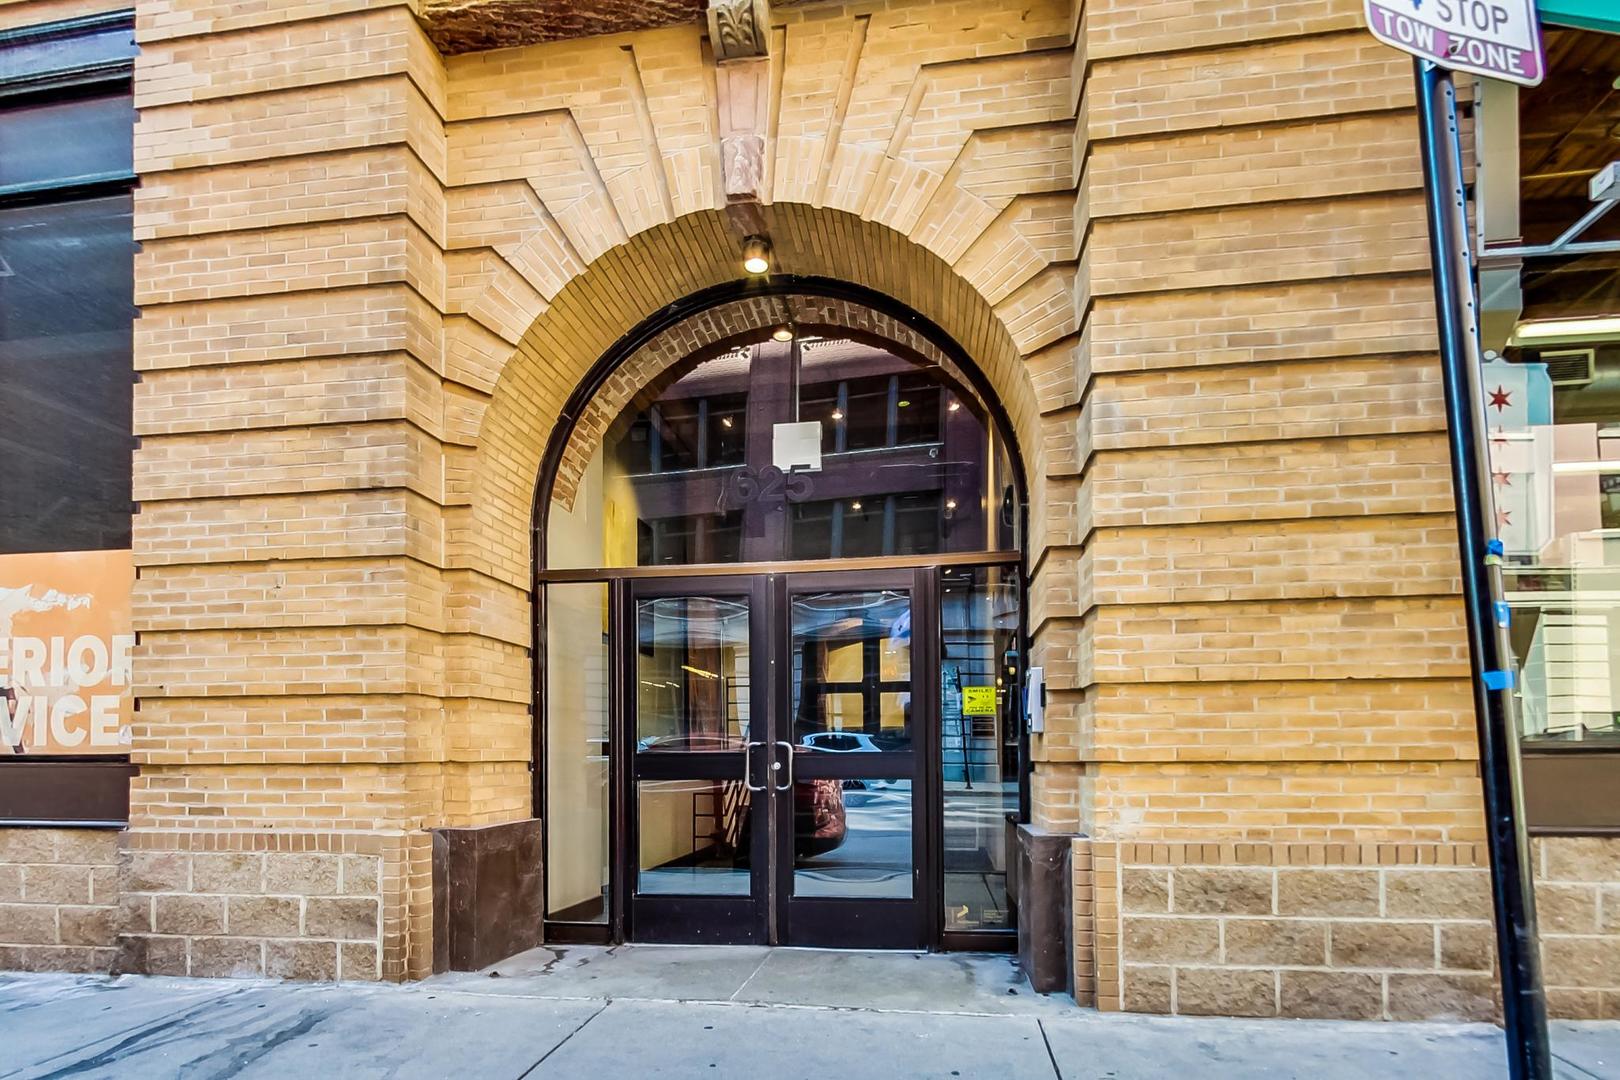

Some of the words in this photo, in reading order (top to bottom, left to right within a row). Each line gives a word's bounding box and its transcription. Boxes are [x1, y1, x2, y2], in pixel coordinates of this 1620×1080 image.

[1436, 0, 1508, 34] STOP
[1378, 8, 1435, 51] TOW
[1447, 34, 1526, 75] ZONE
[730, 464, 815, 502] 625
[0, 694, 120, 747] VICE
